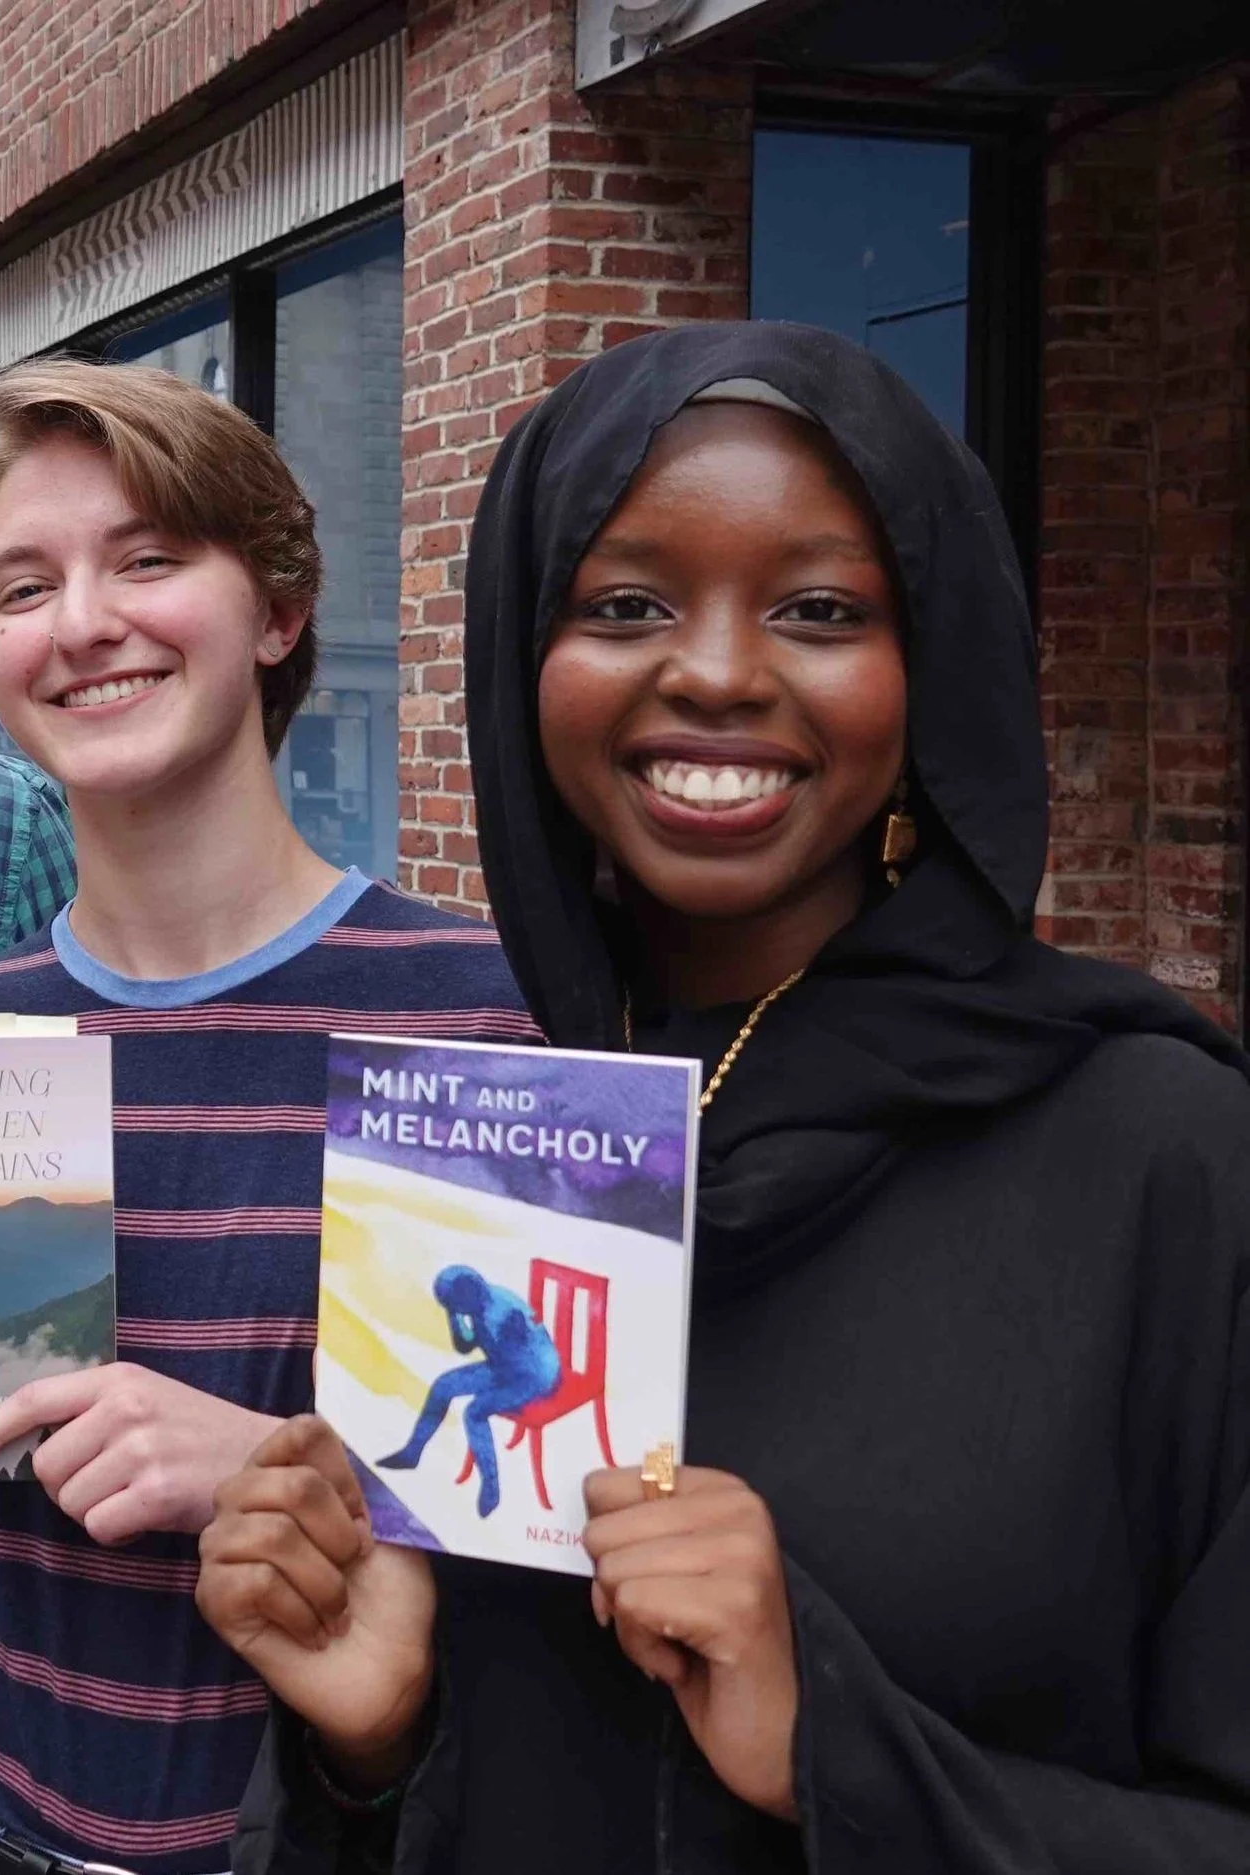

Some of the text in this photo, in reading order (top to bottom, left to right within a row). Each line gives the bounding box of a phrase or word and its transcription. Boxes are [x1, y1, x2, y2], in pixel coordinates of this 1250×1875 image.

[362, 1066, 535, 1113] MINT AND
[360, 1109, 648, 1167] MELANCHOLY
